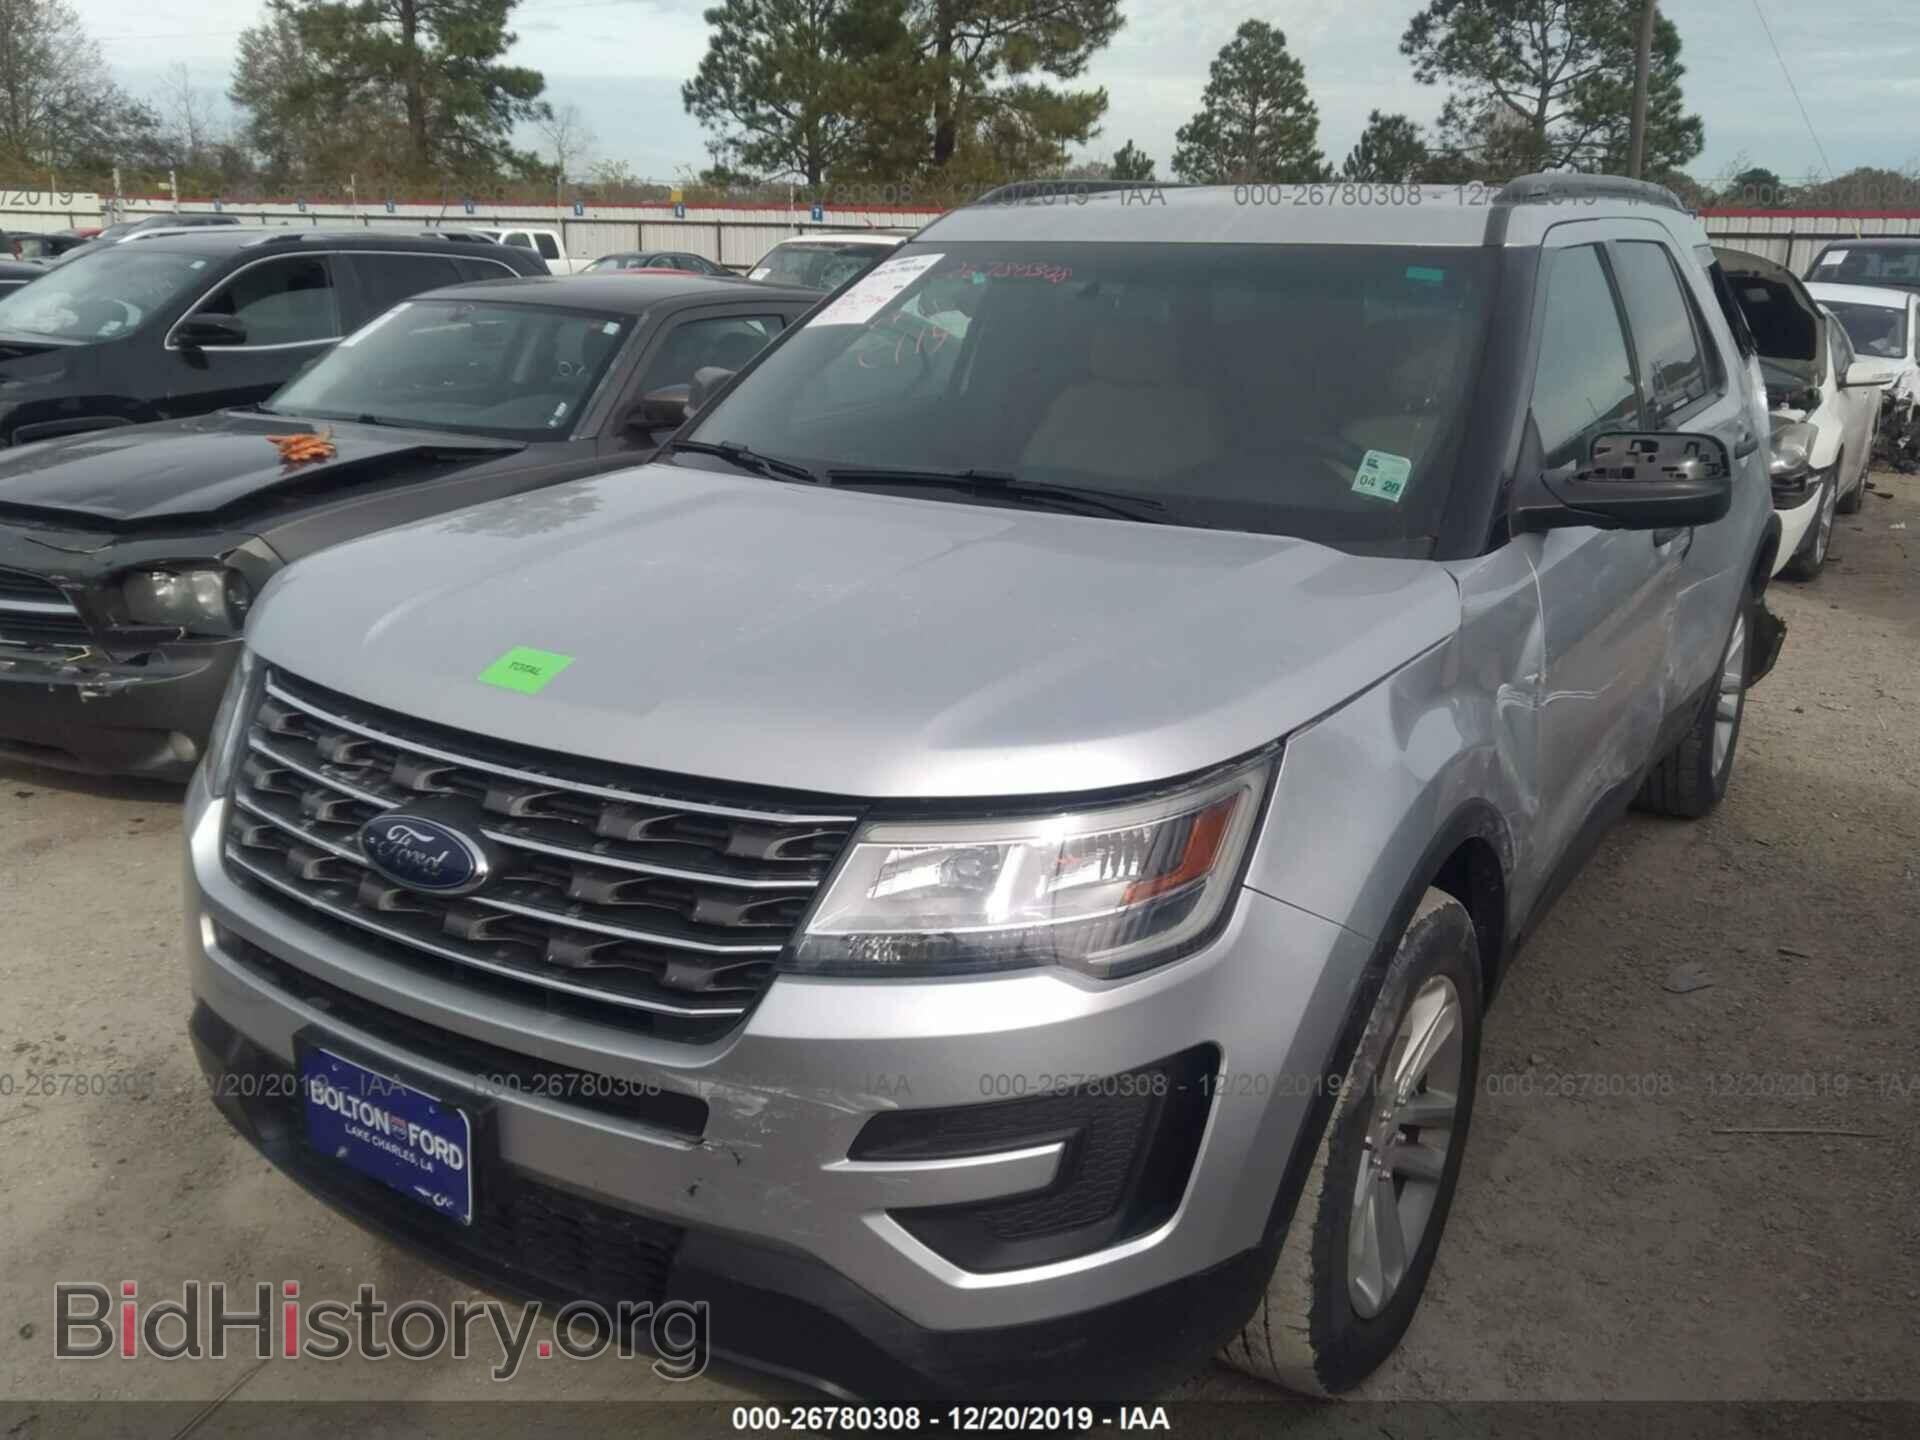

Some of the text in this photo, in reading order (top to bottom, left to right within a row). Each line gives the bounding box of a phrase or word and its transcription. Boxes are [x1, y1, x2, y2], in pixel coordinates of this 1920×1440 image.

[310, 1079, 390, 1136] BOLTON
[407, 1122, 464, 1171] FORD
[344, 1122, 370, 1143] LAKE
[419, 1157, 434, 1173] LA
